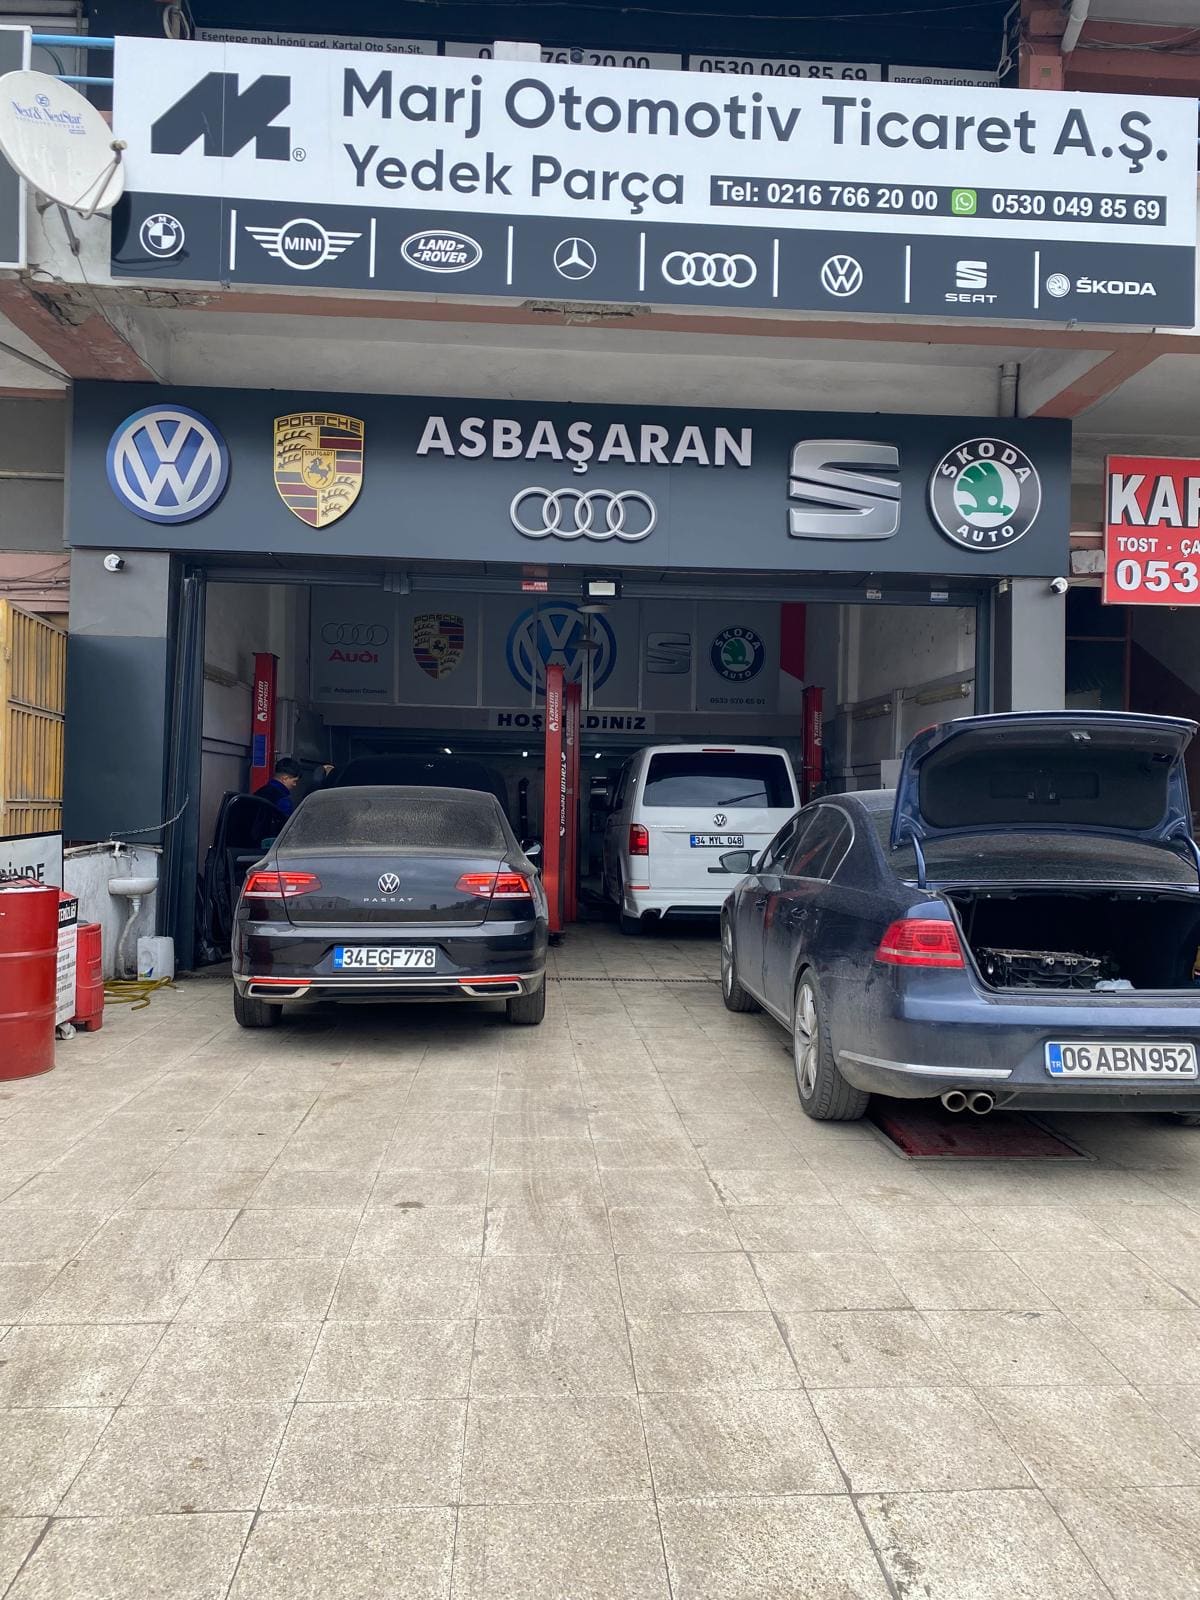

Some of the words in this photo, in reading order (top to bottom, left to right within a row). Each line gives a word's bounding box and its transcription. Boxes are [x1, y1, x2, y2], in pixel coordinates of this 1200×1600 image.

[201, 31, 248, 43] Esentepe
[332, 39, 362, 51] Kartal
[365, 42, 383, 52] Oto
[343, 68, 483, 138] Marj
[505, 78, 801, 142] Otomotiv
[822, 96, 1036, 154] Ticaret
[1053, 107, 1169, 173] A.Ş.
[343, 143, 512, 196] Yedek
[532, 154, 685, 214] Parça
[718, 180, 760, 203] Tel:
[767, 184, 822, 205] 0216
[830, 186, 871, 207] 766
[876, 188, 904, 209] 20
[910, 189, 938, 210] 00
[991, 193, 1046, 215] 0530
[1052, 196, 1093, 217] 049
[1099, 197, 1127, 219] 85
[1133, 199, 1161, 220] 69
[146, 215, 179, 231] BMW
[284, 236, 322, 252] MINI
[418, 238, 456, 251] LAND
[421, 250, 467, 264] ROVER
[1076, 276, 1157, 297] ŠKODA
[945, 293, 998, 304] SEAT
[276, 415, 363, 432] PORSCHE
[416, 415, 753, 473] ASBAŞARAN
[956, 523, 1015, 543] AUTO
[1117, 536, 1159, 553] TOST
[328, 649, 379, 664] Audi
[722, 669, 753, 681] AUTO
[497, 712, 542, 731] HOŞ
[695, 836, 706, 845] 34
[709, 836, 724, 845] MYL
